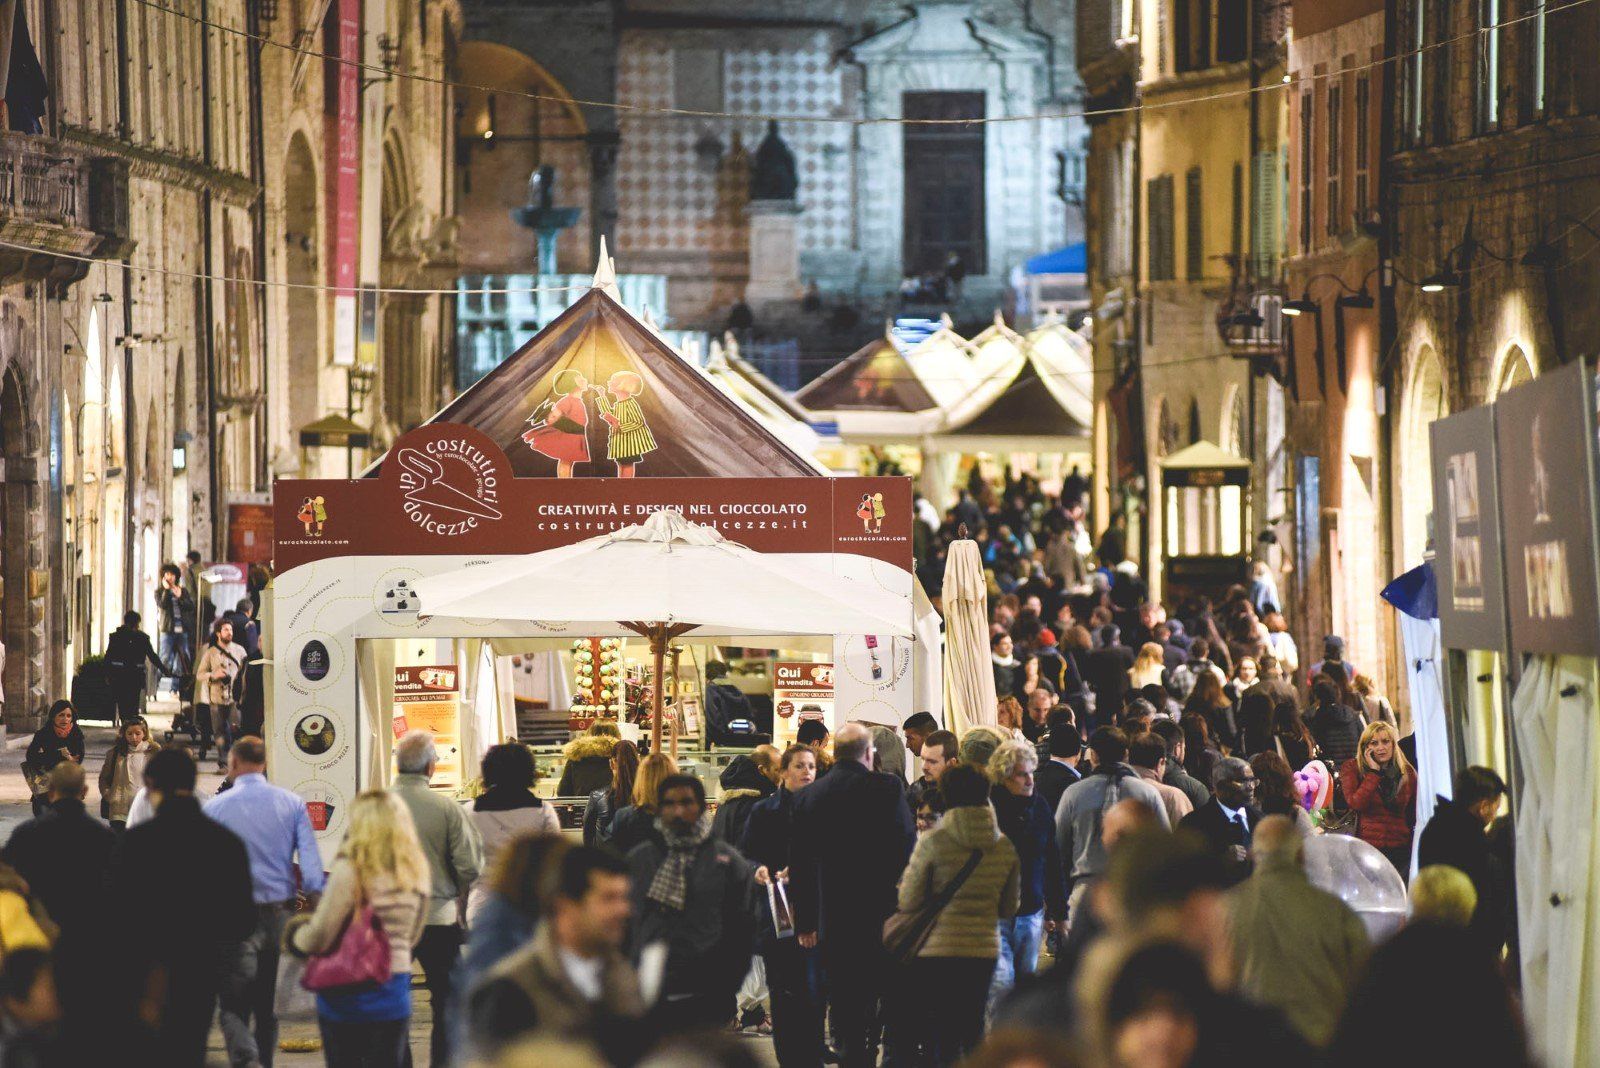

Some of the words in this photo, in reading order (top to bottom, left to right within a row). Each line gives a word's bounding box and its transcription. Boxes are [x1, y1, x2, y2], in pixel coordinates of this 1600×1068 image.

[426, 439, 498, 503] costruttori
[400, 473, 416, 489] di
[538, 502, 617, 515] CREATIVITÀ
[623, 504, 630, 515] E
[636, 504, 683, 515] DESIGN
[690, 504, 714, 514] NEL
[719, 504, 806, 515] CIOCCOLATO
[403, 502, 478, 536] dolcezze
[394, 671, 409, 681] ui
[777, 667, 801, 678] Qui
